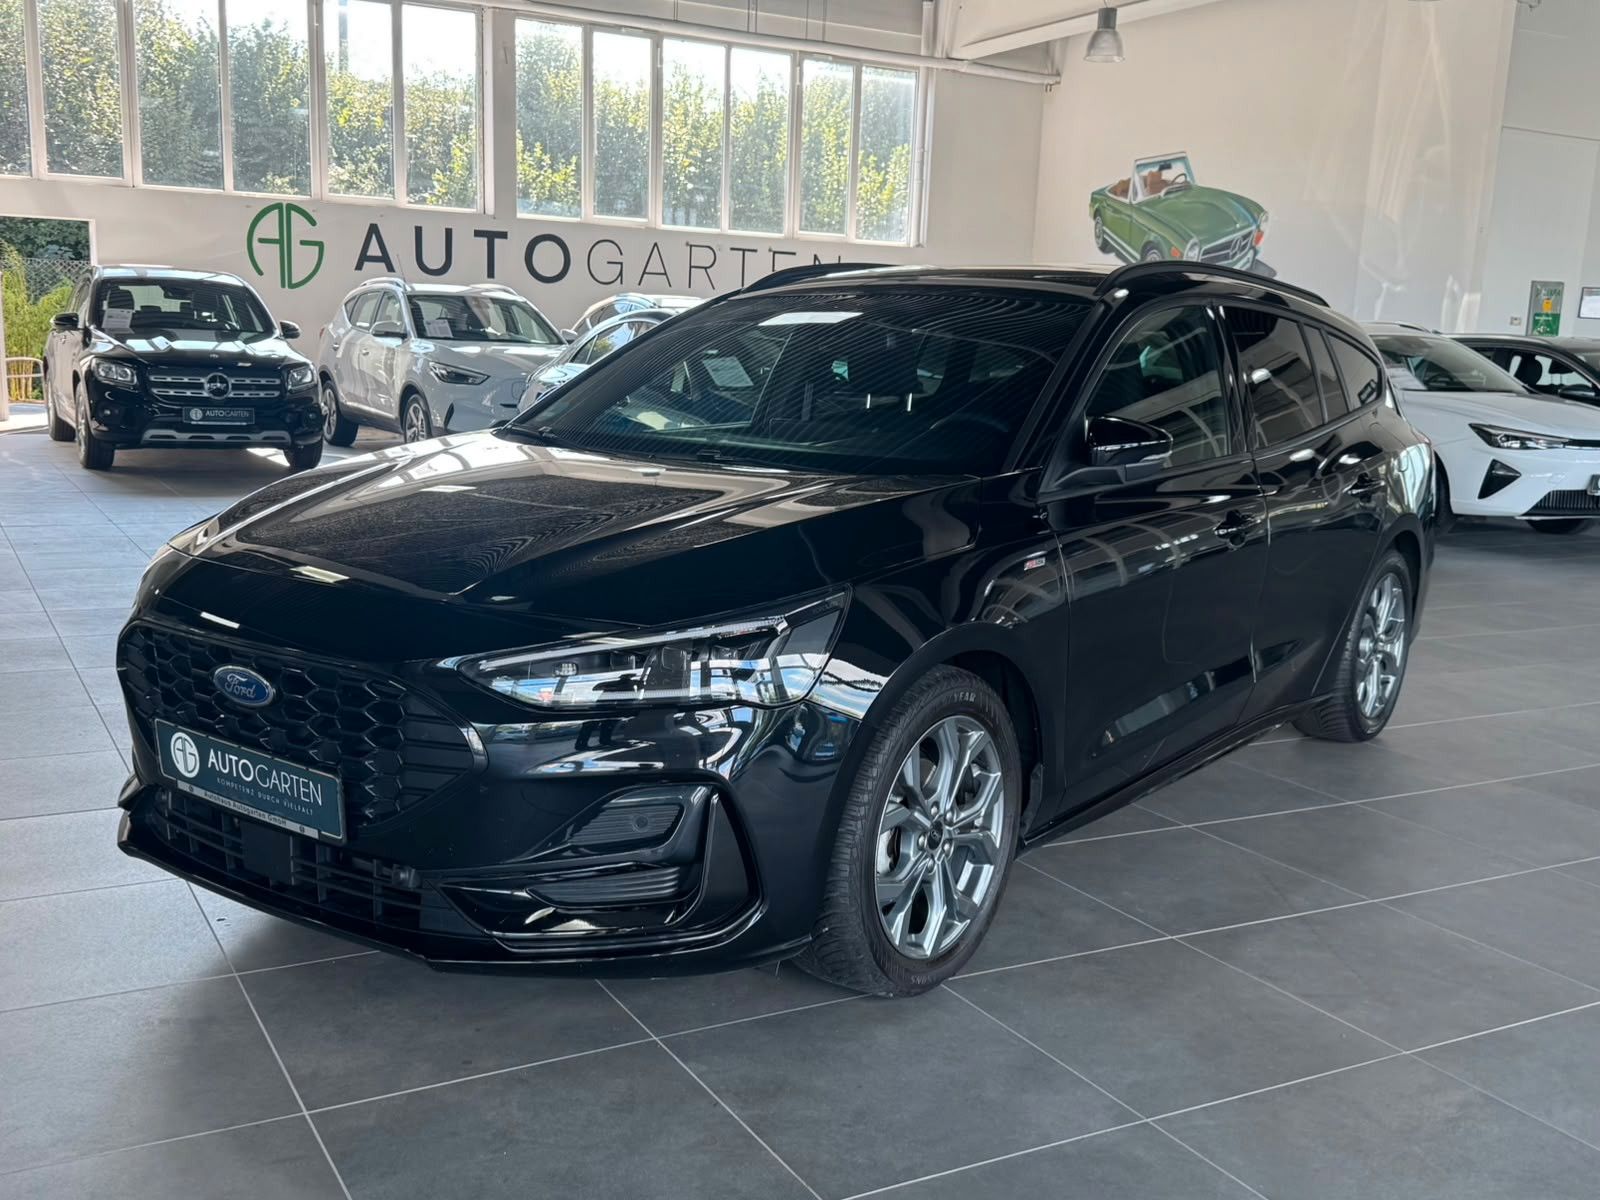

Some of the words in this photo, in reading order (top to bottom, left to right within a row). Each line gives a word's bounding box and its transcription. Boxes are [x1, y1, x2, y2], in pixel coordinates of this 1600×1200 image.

[355, 223, 841, 291] AUTOGART
[225, 673, 257, 698] Ford
[207, 748, 322, 806] AUTOGARTEN
[232, 800, 267, 820] Autogarten
[267, 814, 287, 826] GmbH
[257, 792, 280, 805] DURCH
[283, 798, 313, 816] VIELFALT
